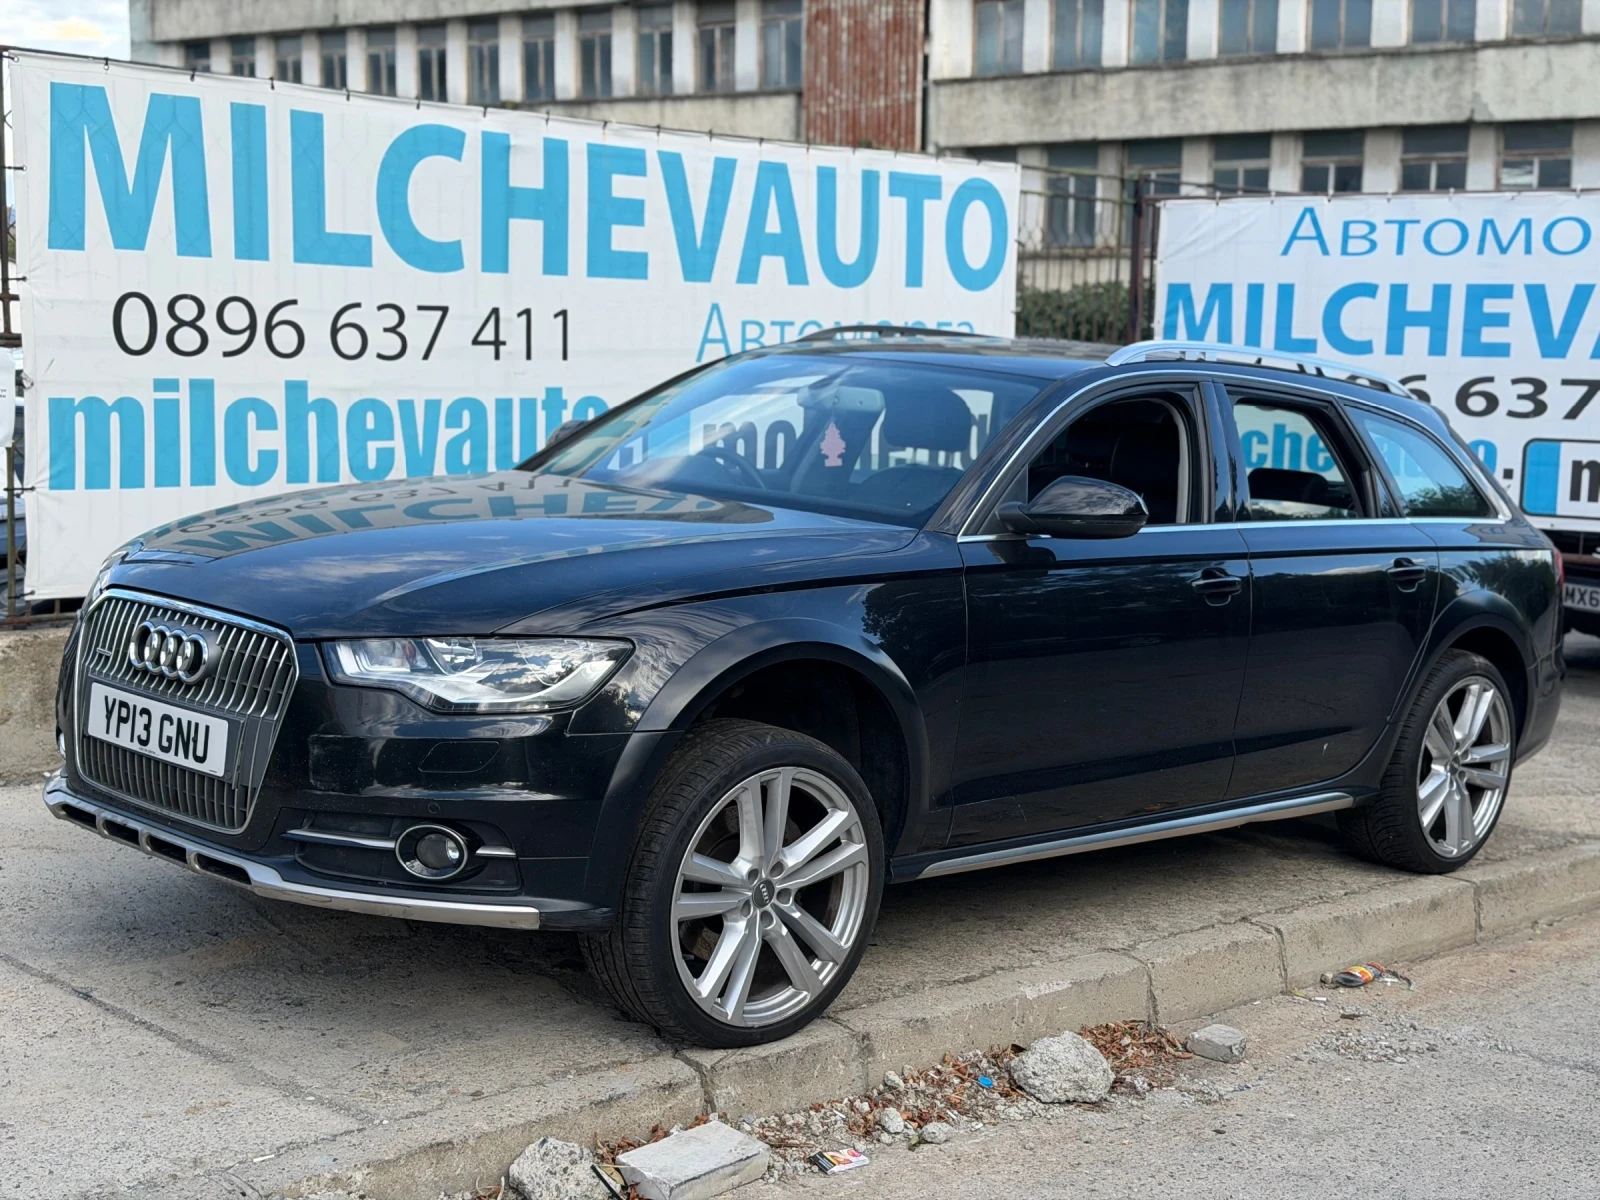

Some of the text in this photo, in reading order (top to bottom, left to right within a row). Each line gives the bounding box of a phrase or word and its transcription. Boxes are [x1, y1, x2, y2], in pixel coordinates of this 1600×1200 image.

[48, 81, 1009, 293] MILCHEVAUTO
[113, 291, 568, 361] 0896 637 411
[1162, 281, 1600, 359] MILCHEV
[1455, 376, 1600, 420] 637
[104, 695, 211, 764] YP13 GNU
